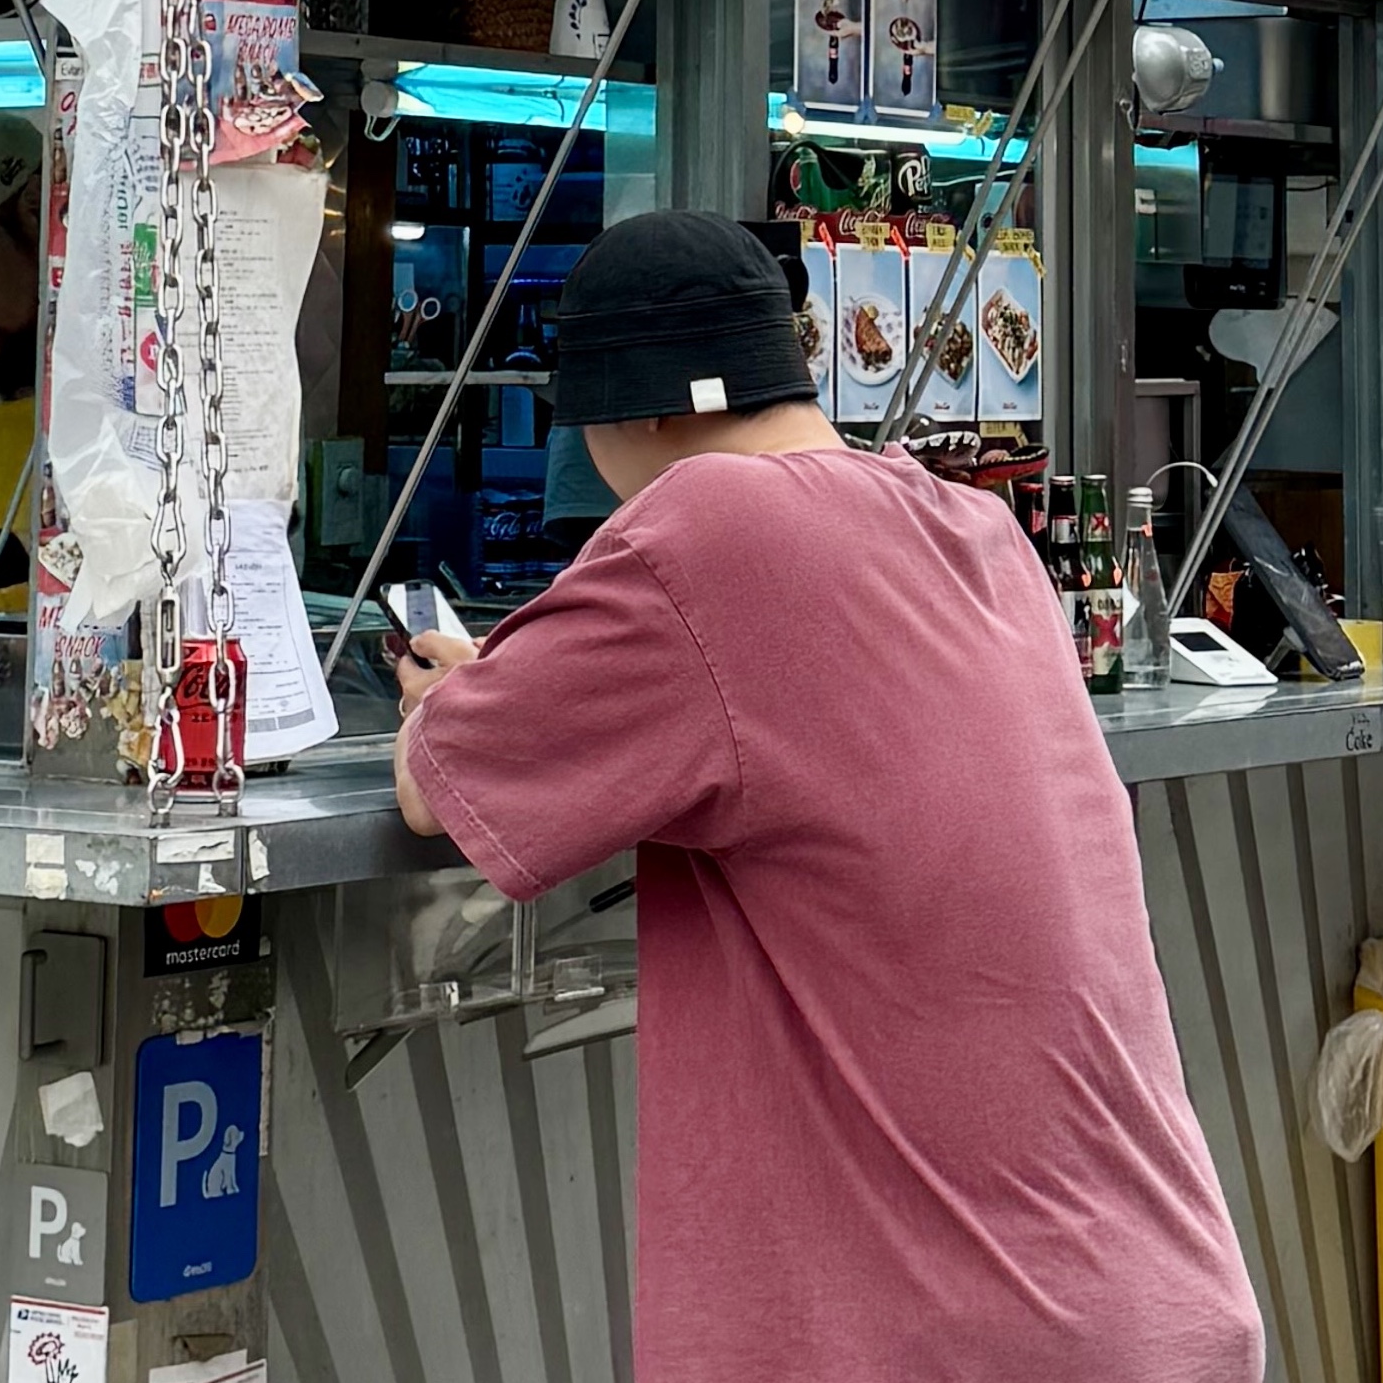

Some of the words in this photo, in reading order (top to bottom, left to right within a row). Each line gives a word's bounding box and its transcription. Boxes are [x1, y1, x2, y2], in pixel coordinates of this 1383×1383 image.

[166, 939, 241, 966] mastercard
[159, 1080, 219, 1208] P
[28, 1185, 67, 1260] P
